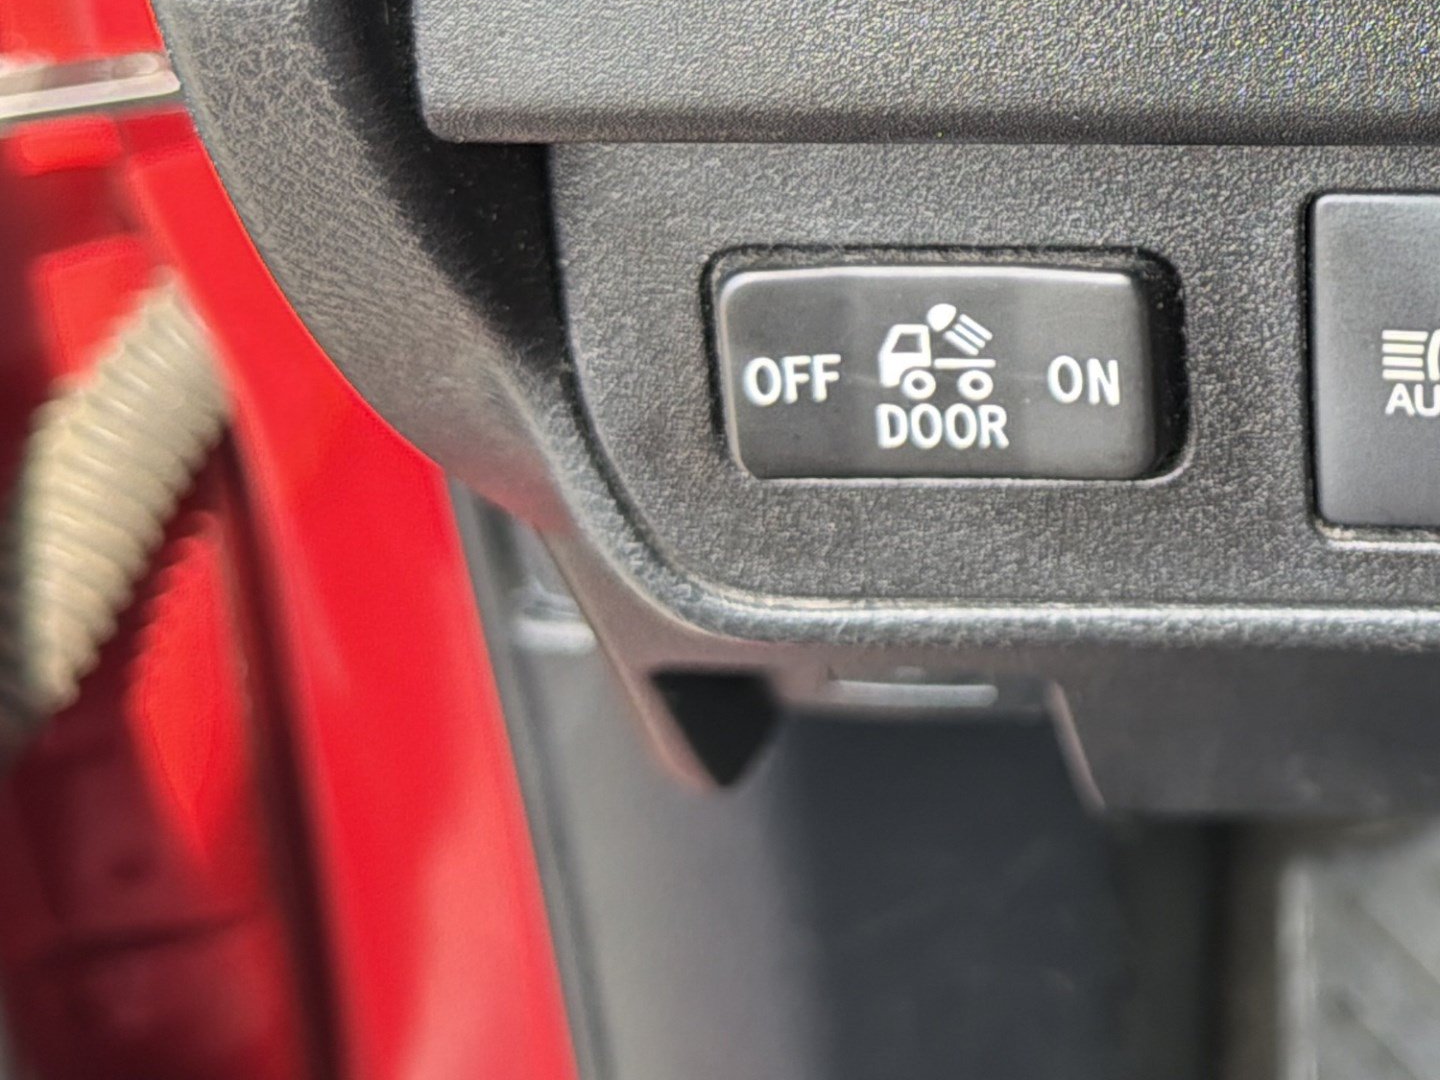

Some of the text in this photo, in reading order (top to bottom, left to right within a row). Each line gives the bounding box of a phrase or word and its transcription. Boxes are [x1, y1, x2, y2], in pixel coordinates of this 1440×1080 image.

[743, 353, 842, 407] OFF
[1046, 354, 1121, 407] ON
[875, 402, 1010, 450] DOOR
